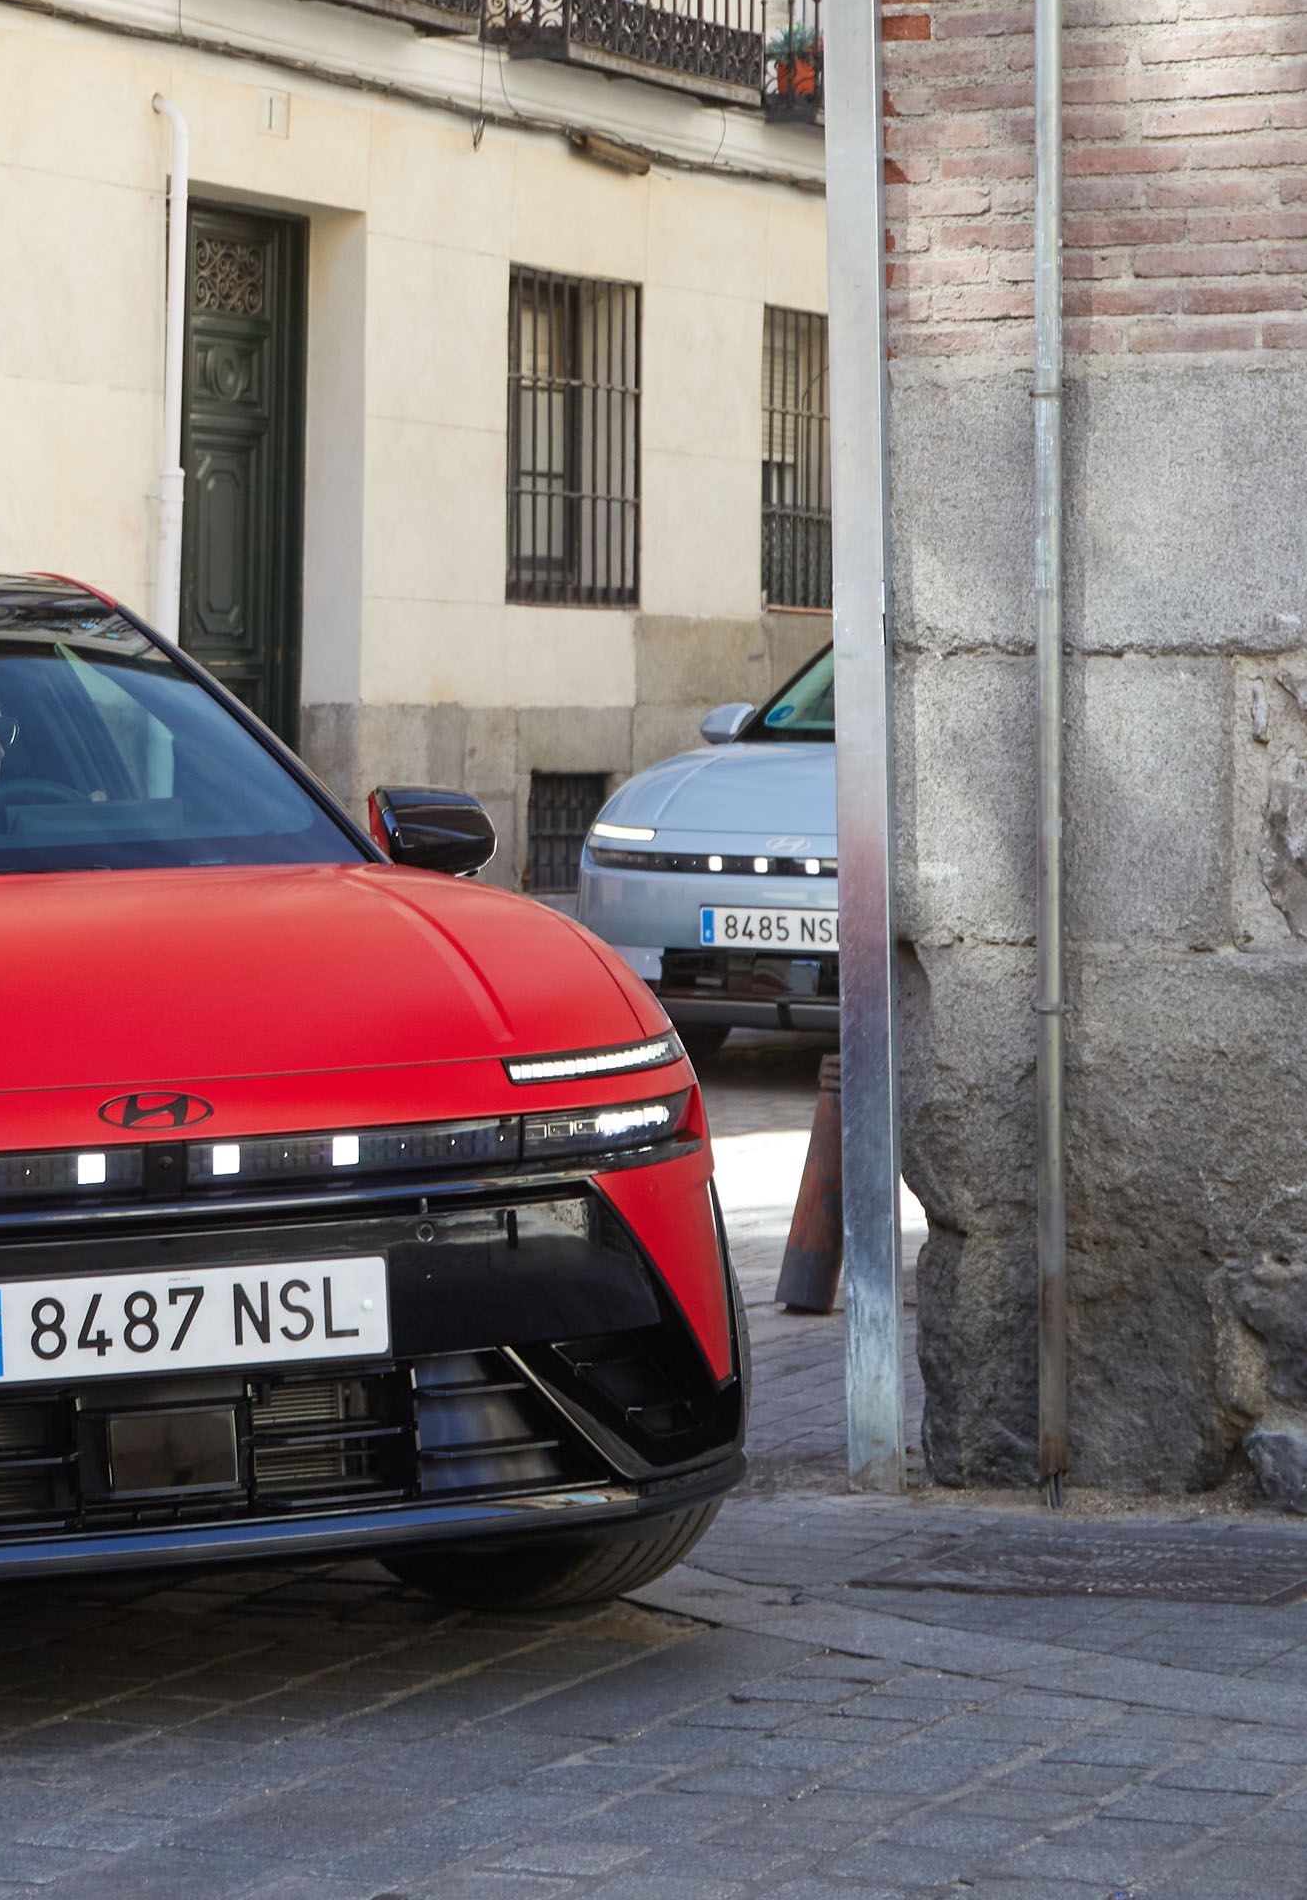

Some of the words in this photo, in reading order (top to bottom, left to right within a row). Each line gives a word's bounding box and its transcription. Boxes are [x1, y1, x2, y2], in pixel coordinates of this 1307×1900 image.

[724, 915, 790, 942] 8485
[30, 1285, 205, 1360] 8487
[232, 1276, 360, 1346] NSL
